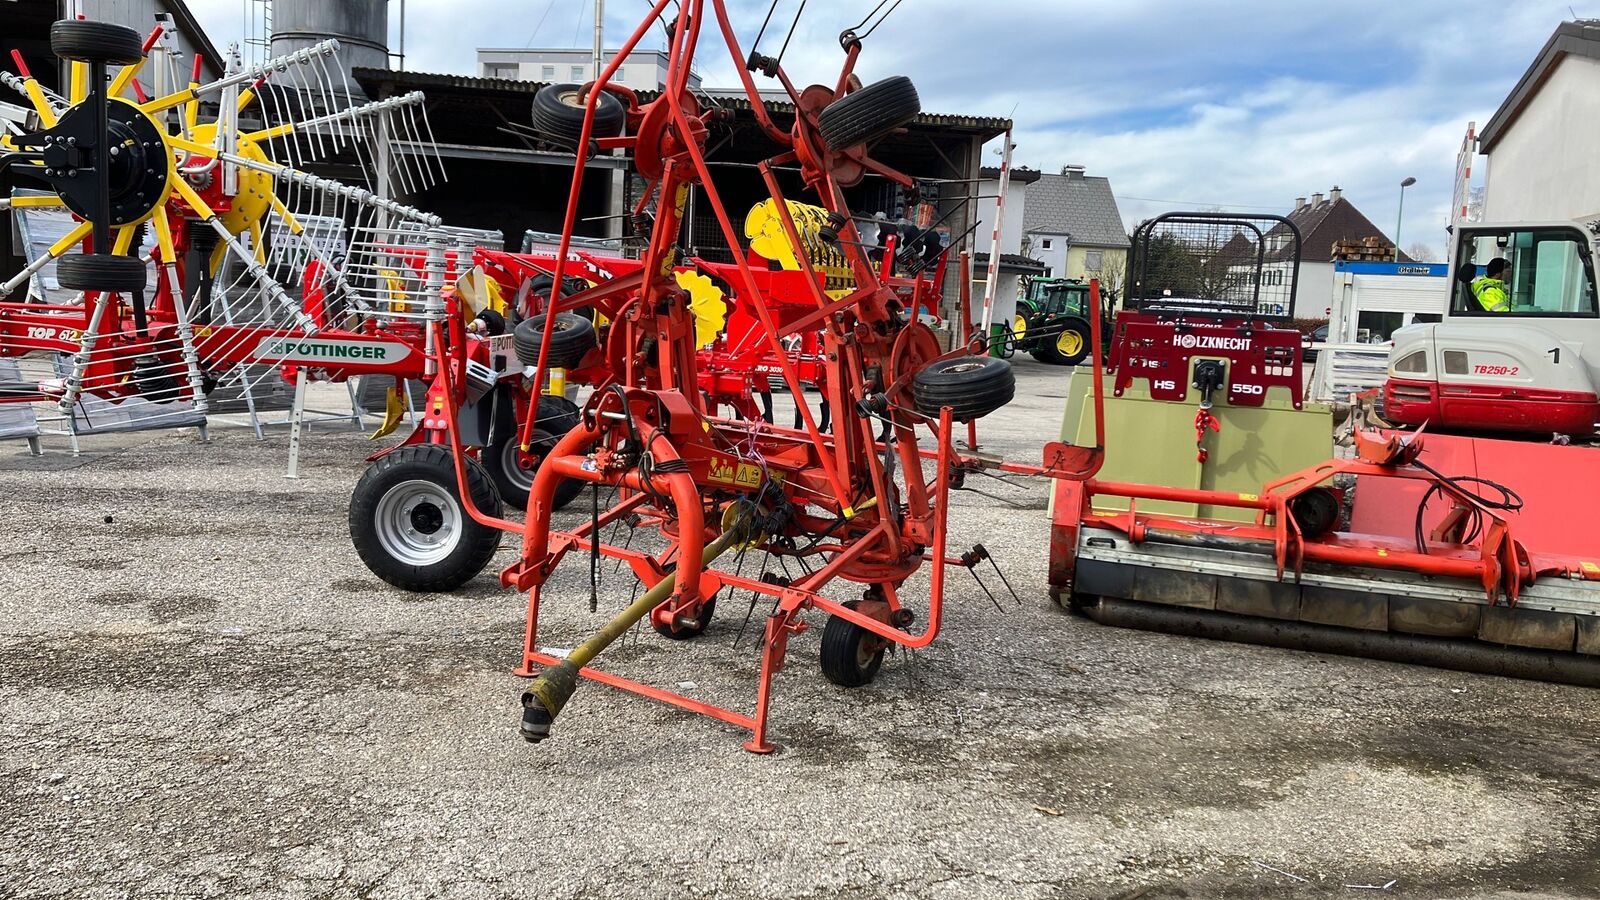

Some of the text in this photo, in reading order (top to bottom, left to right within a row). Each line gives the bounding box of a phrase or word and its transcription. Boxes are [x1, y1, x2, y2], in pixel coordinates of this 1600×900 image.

[27, 327, 77, 342] TOP 612
[1173, 334, 1252, 351] HOLZKNECHT
[286, 342, 386, 359] PÖTTINGER
[1547, 347, 1560, 364] 1
[1474, 365, 1519, 376] TB250-2
[1154, 380, 1263, 395] HS 550
